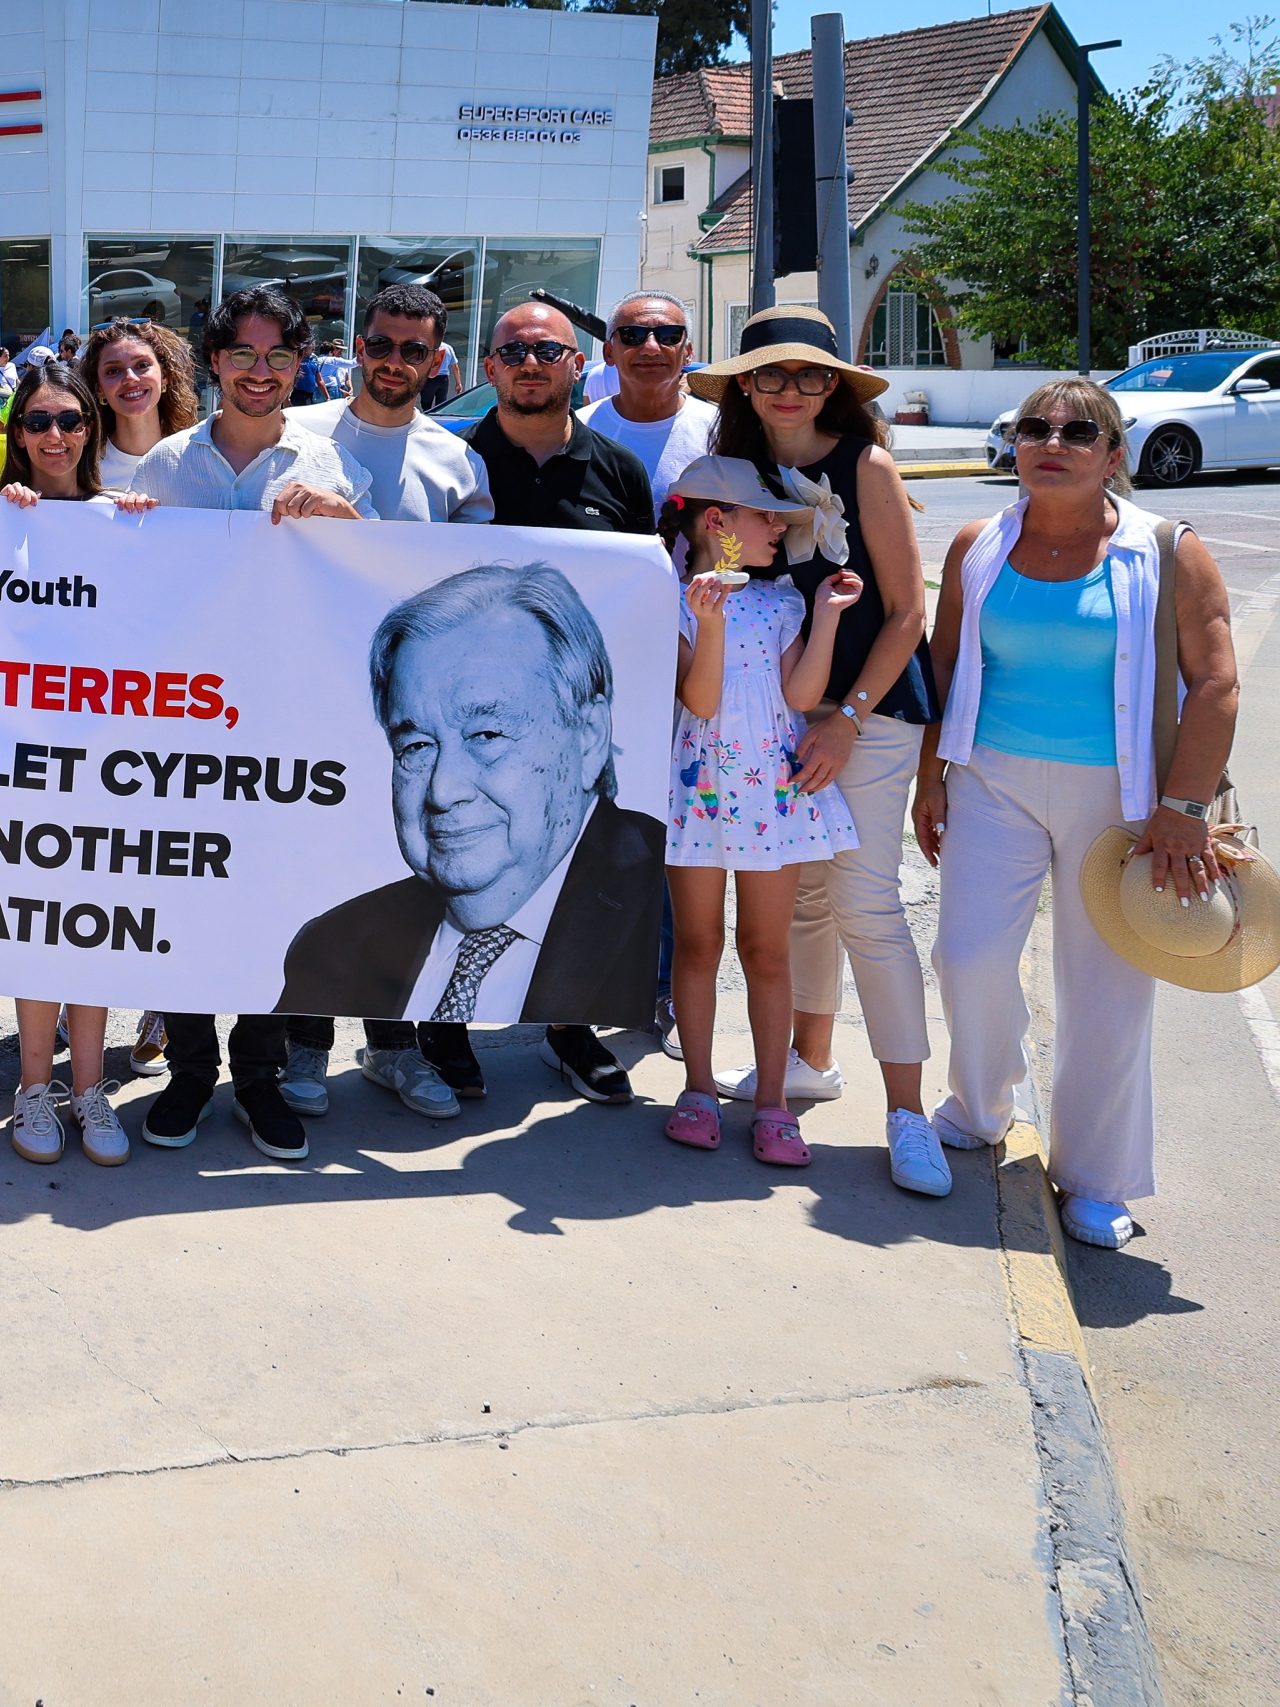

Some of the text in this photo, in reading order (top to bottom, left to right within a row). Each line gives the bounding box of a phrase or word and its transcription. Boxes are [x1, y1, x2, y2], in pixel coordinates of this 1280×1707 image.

[459, 104, 612, 125] SUPER SPORT CARS
[458, 128, 581, 144] 0533 880 01 03
[100, 749, 347, 806] CYPRUS
